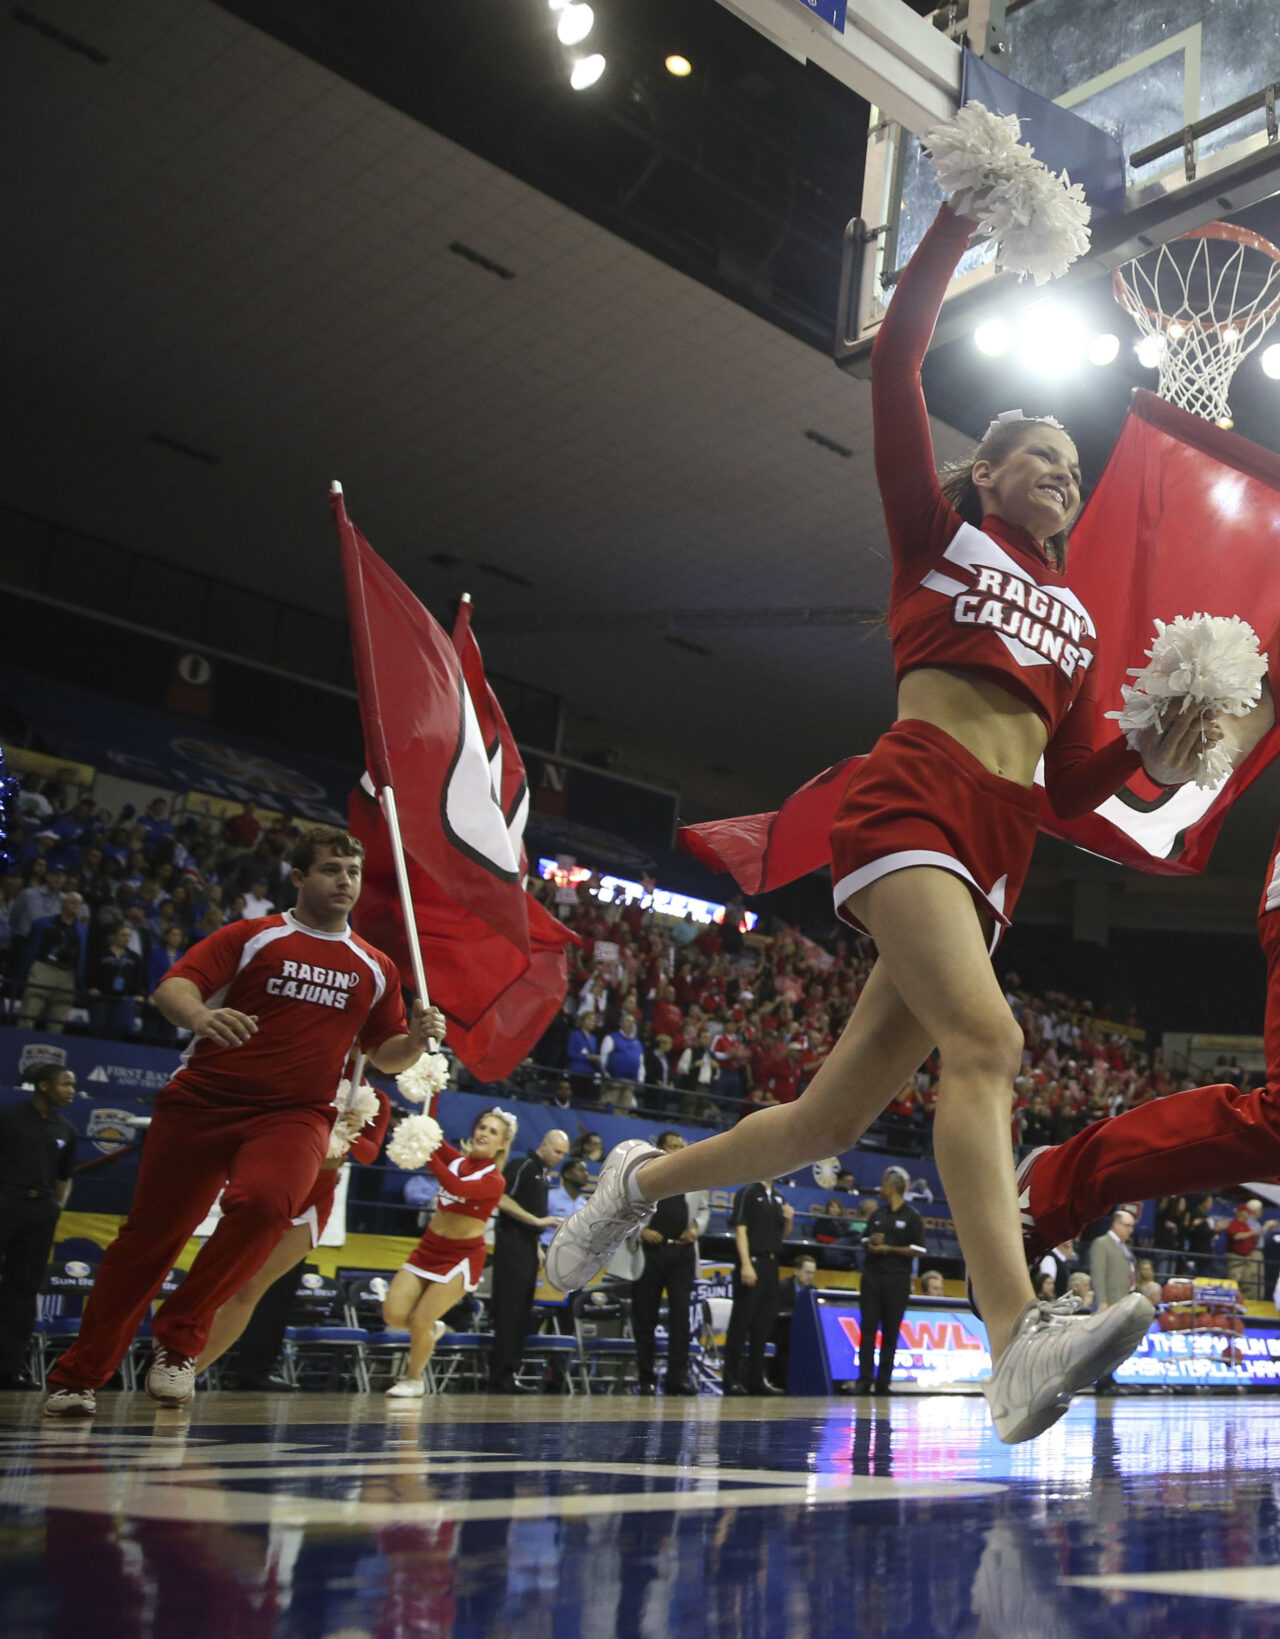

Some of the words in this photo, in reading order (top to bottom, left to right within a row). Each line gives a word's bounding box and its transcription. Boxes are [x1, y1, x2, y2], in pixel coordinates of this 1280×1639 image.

[953, 595, 1082, 680] CAJUNS
[265, 977, 350, 1010] CAJUNS
[106, 1064, 144, 1080] FIRST
[145, 1069, 170, 1082] BAN
[77, 1278, 96, 1287] BE
